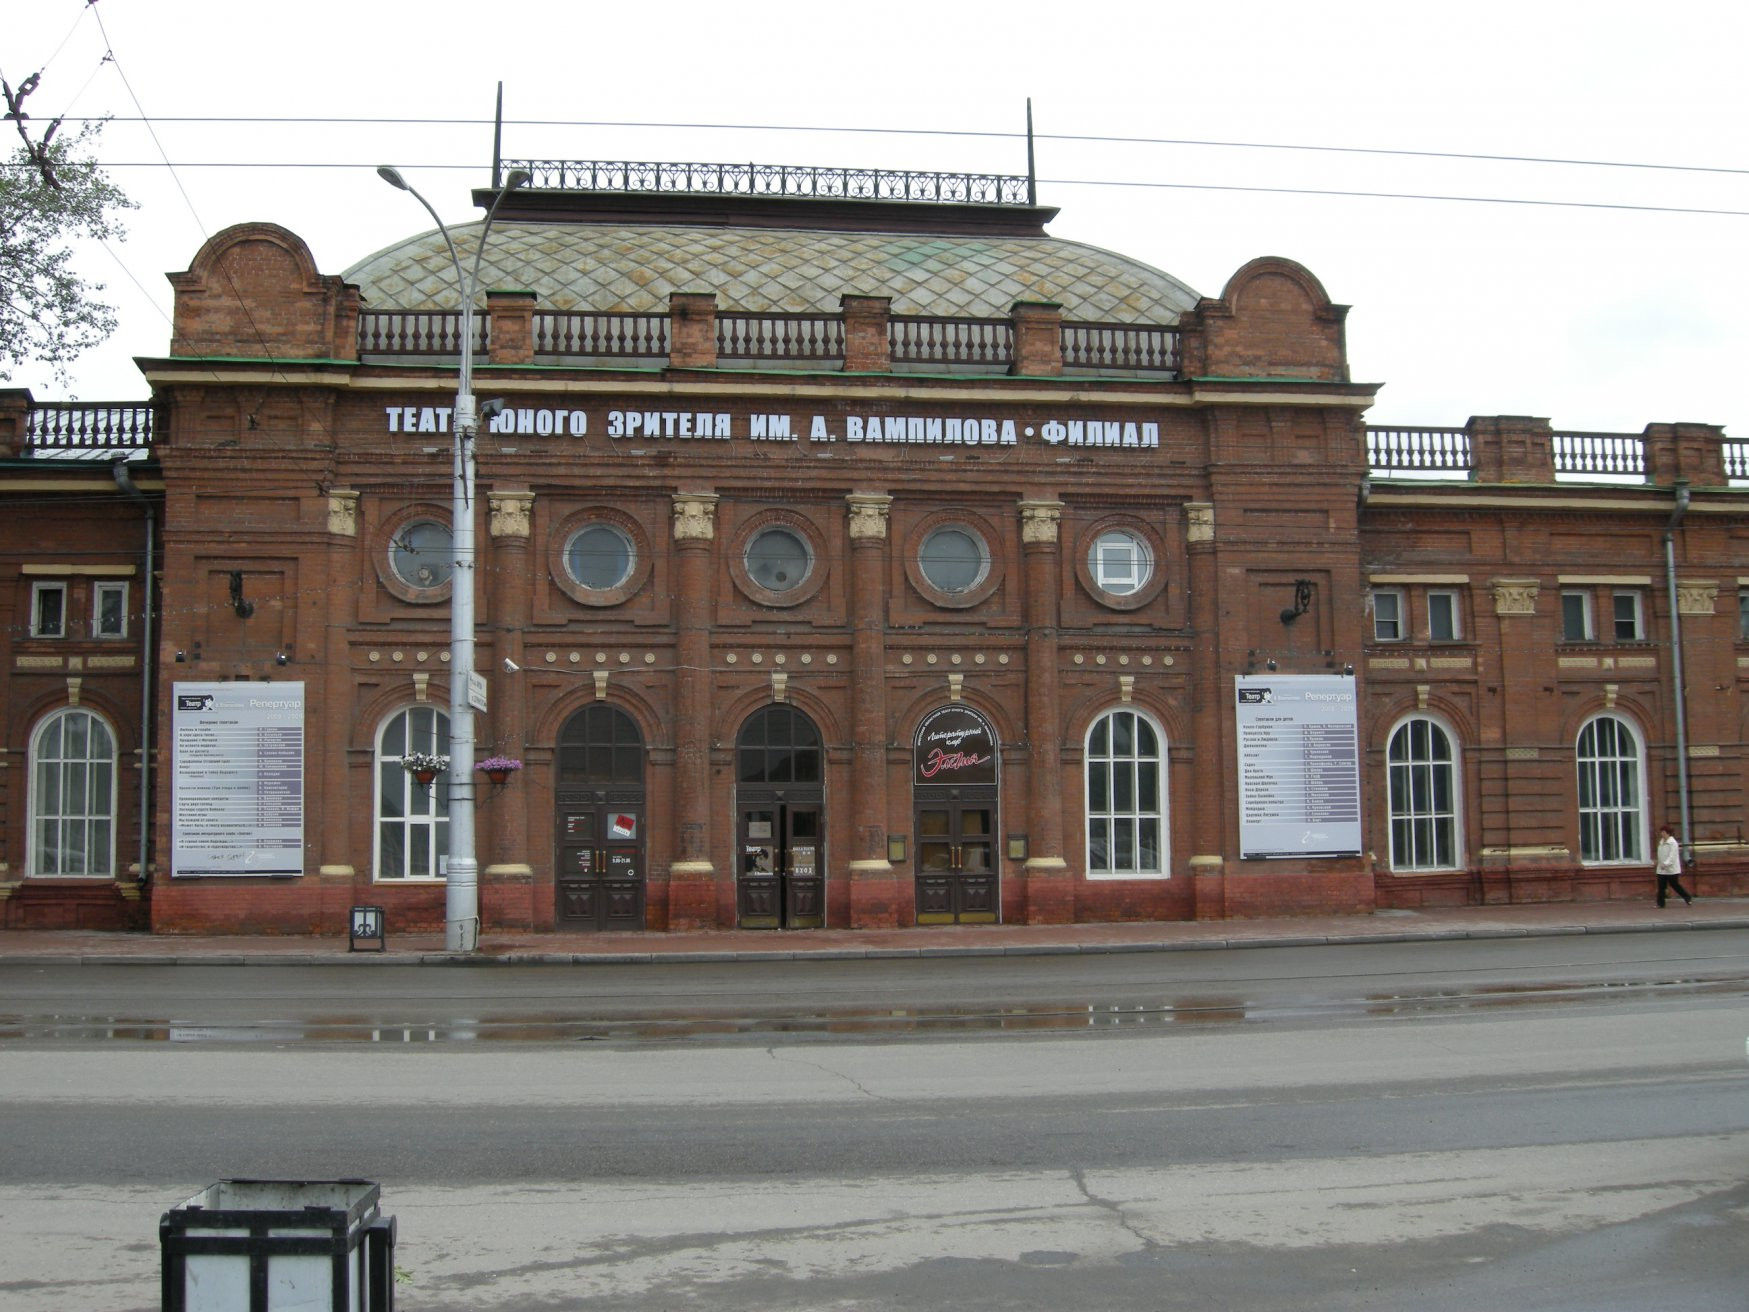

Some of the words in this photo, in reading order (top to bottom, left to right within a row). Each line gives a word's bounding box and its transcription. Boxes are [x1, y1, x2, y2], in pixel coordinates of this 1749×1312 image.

[385, 407, 457, 434] ТЕАТ
[489, 408, 588, 438] ЮНОГО
[607, 410, 732, 440] ЗРИТЕЛЯ
[749, 413, 798, 441] ИМ.
[809, 415, 837, 442] А.
[846, 416, 1018, 446] ВАМПИЛОВА
[1041, 419, 1160, 448] ФИЛИАЛ
[1305, 691, 1352, 702] Репертуар
[249, 699, 301, 710] Репертуар
